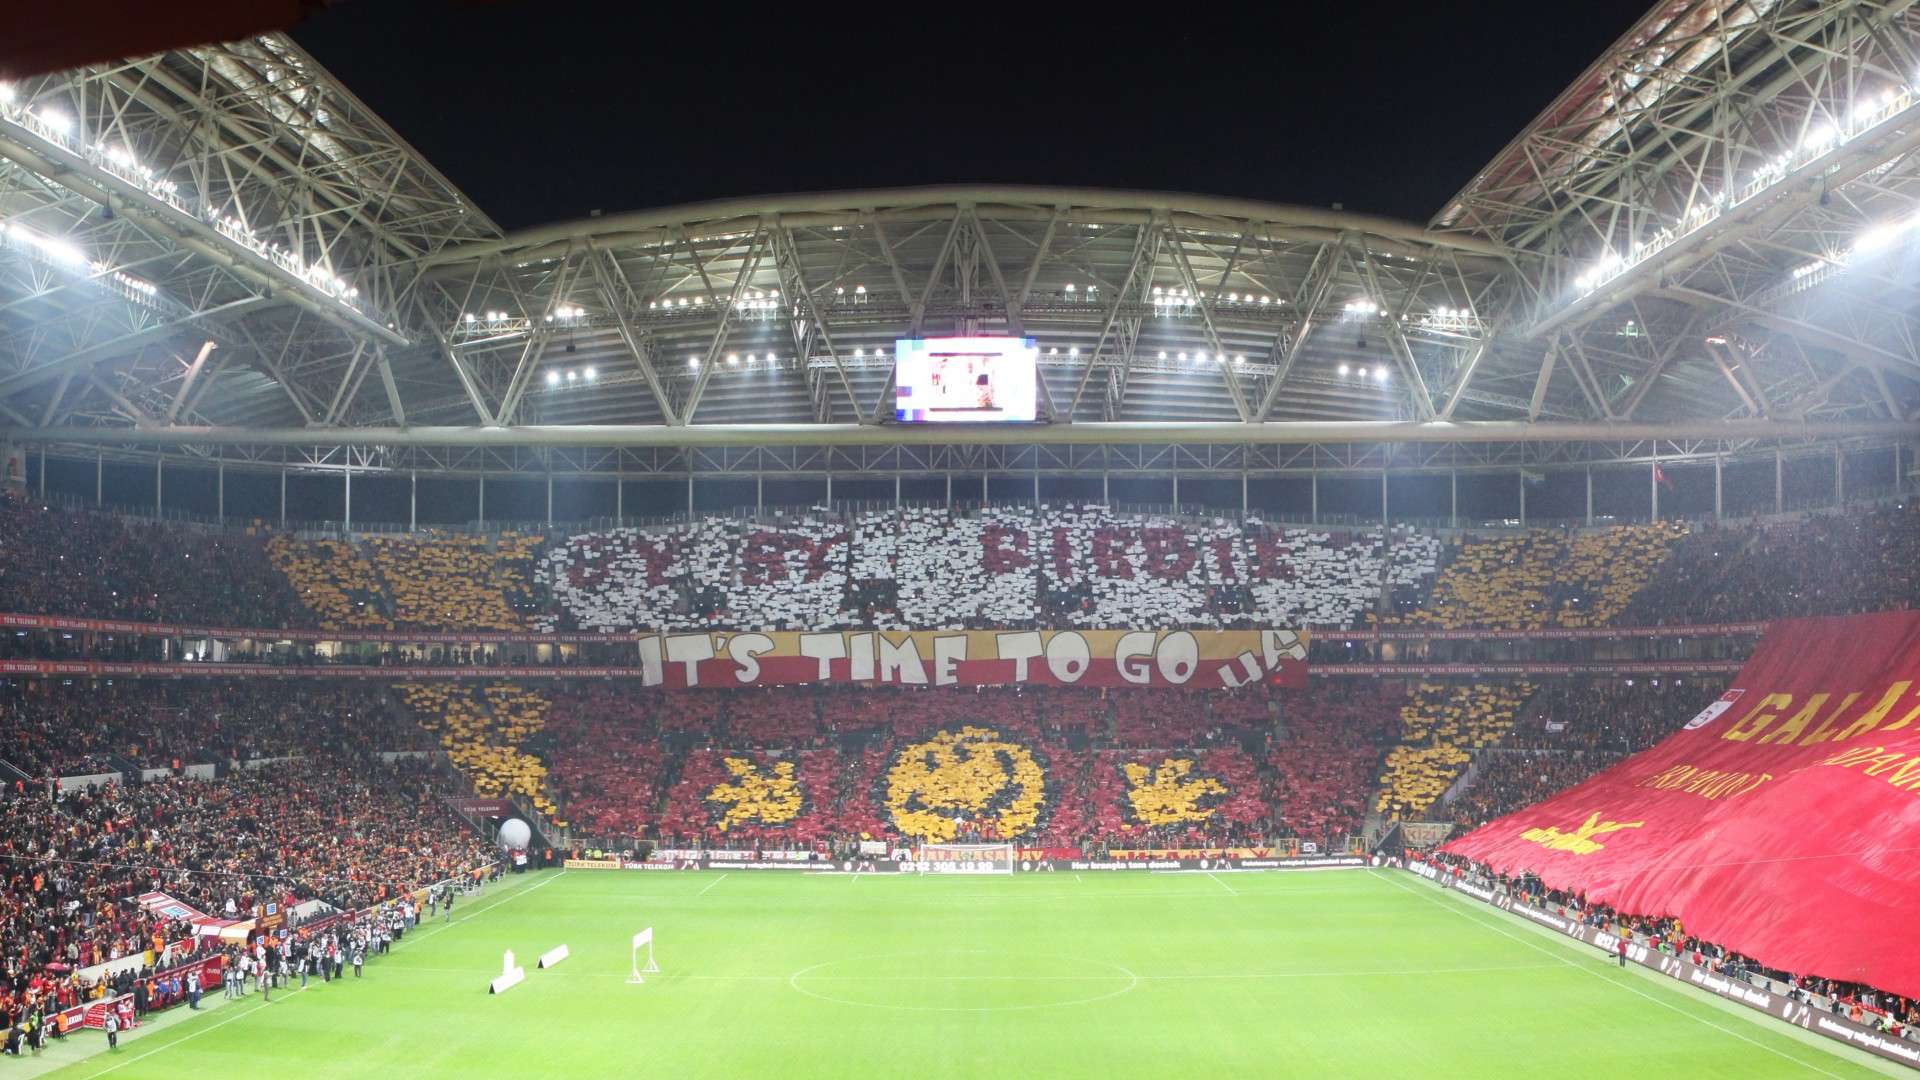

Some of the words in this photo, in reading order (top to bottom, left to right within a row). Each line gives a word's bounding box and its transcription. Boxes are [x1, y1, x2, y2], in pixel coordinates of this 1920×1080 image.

[638, 632, 775, 687] IT'S
[800, 632, 967, 685] TIME
[997, 631, 1090, 683] TO
[1115, 631, 1200, 684] GO
